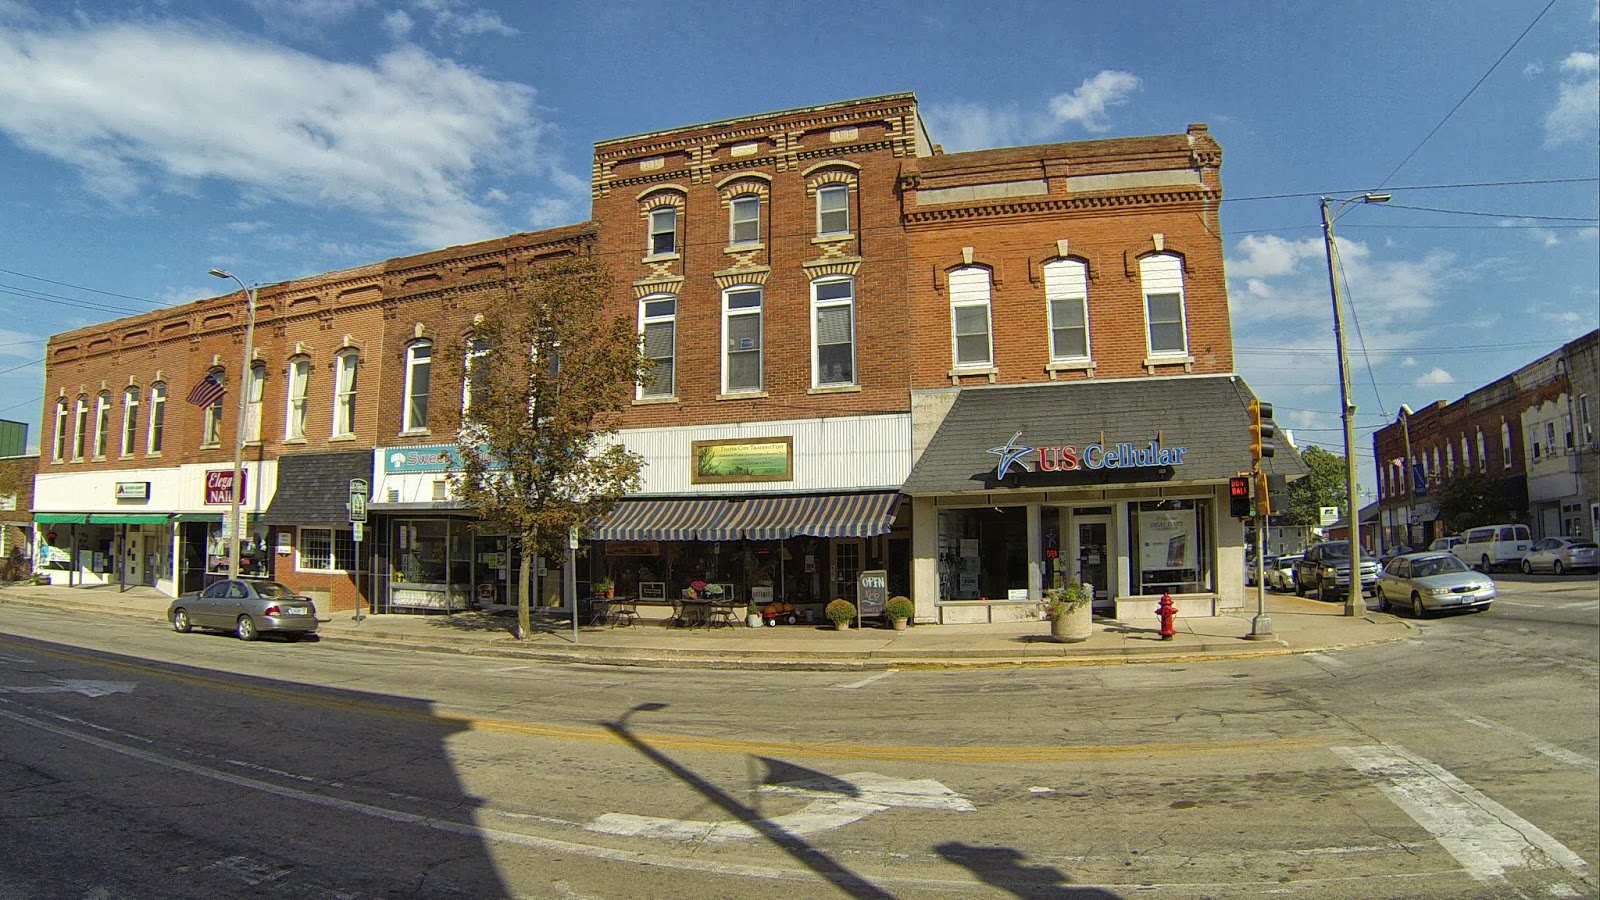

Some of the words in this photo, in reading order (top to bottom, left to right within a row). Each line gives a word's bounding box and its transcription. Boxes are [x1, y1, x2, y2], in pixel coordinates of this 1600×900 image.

[1037, 445, 1081, 471] U.S.
[1083, 440, 1187, 469] Cellular
[208, 472, 235, 490] Elega
[210, 490, 235, 503] NAIL
[1231, 487, 1248, 495] WALK
[862, 576, 885, 588] OPEN
